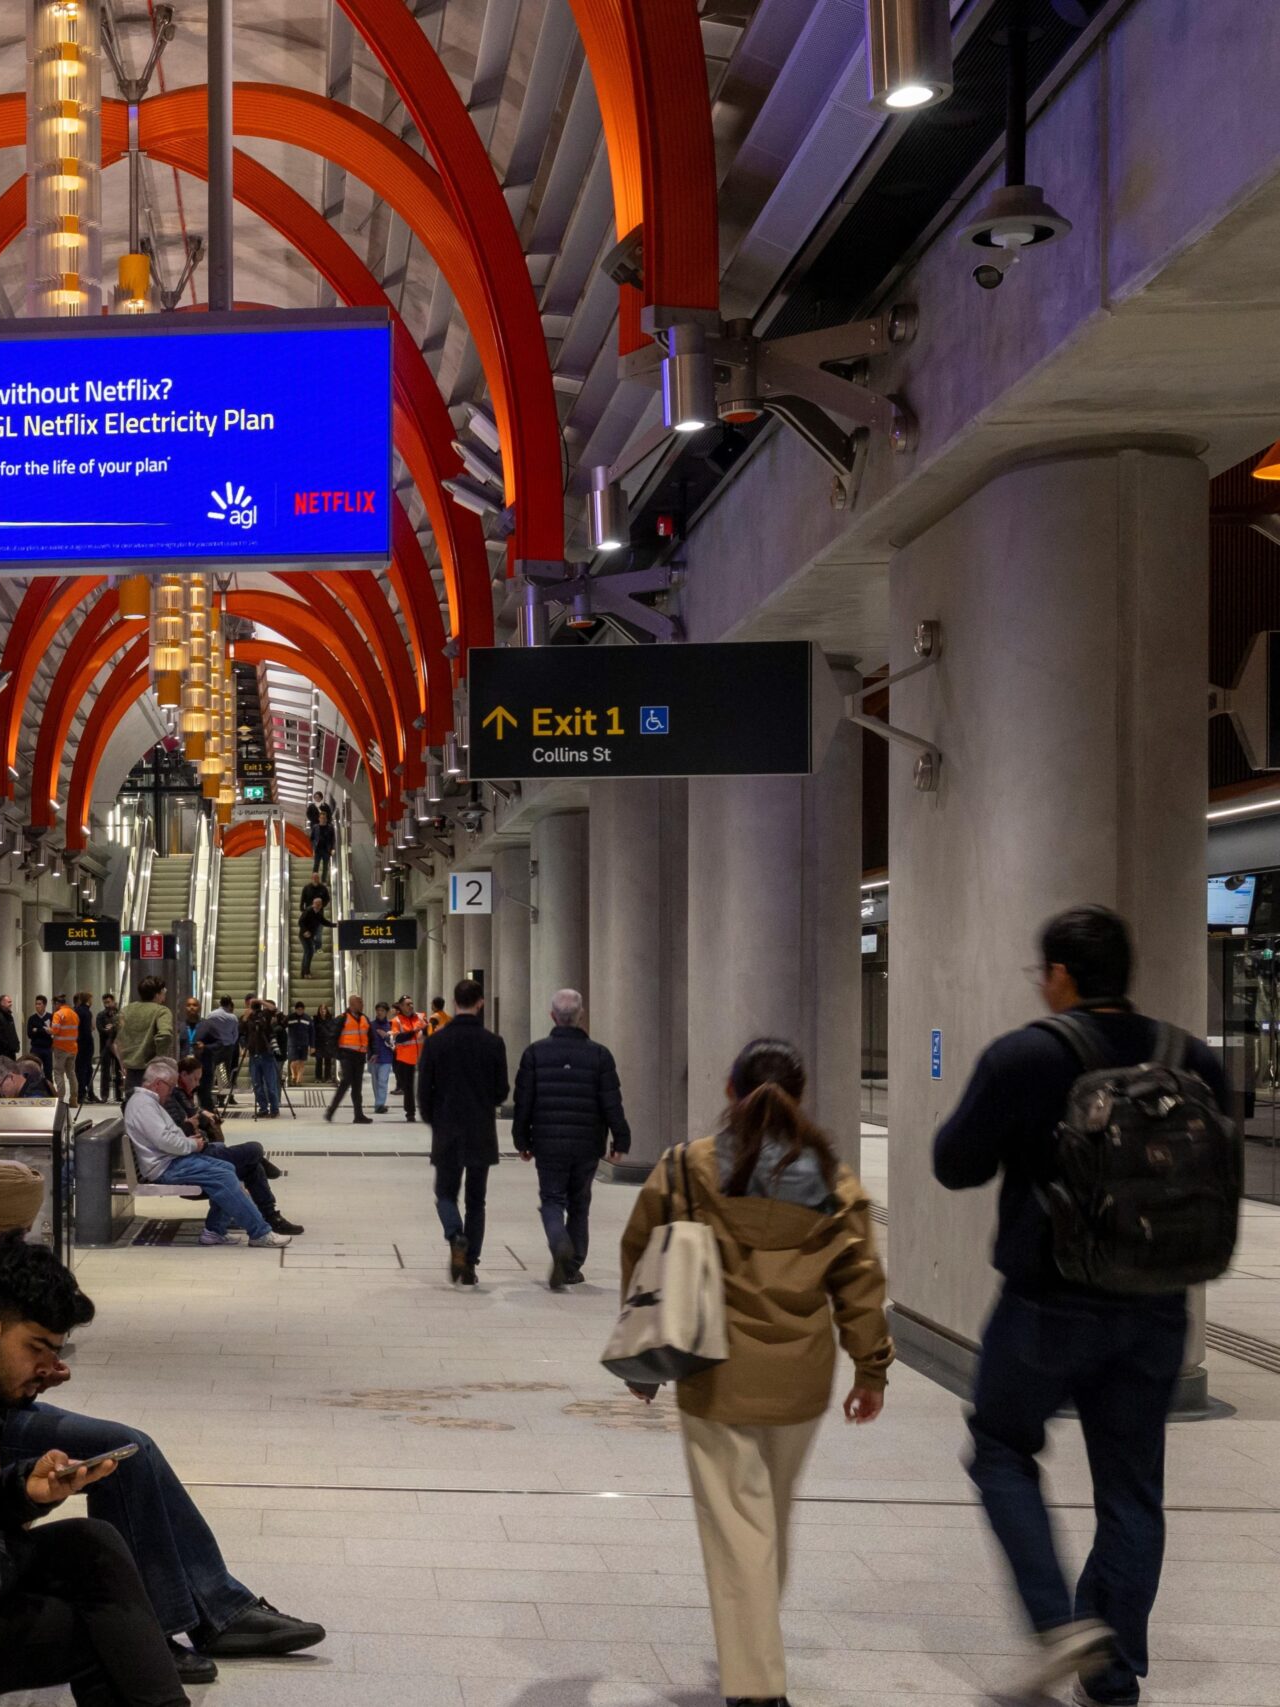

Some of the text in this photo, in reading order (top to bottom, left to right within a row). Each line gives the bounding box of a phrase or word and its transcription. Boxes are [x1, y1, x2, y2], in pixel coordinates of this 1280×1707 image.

[85, 378, 173, 402] Netflix?
[24, 413, 98, 437] Netflix
[105, 410, 217, 437] Electricity
[224, 408, 274, 431] Plan
[0, 461, 21, 476] for
[24, 460, 49, 475] the
[52, 459, 76, 475] life
[79, 458, 96, 474] of
[98, 461, 132, 478] your
[294, 490, 375, 516] NETFLIX
[229, 505, 258, 529] agl
[532, 706, 624, 737] Exit 1
[532, 746, 612, 763] Collins St
[244, 763, 258, 771] Exit
[465, 880, 483, 906] 2
[68, 928, 96, 938] Exit 1
[362, 926, 392, 936] Exit 1
